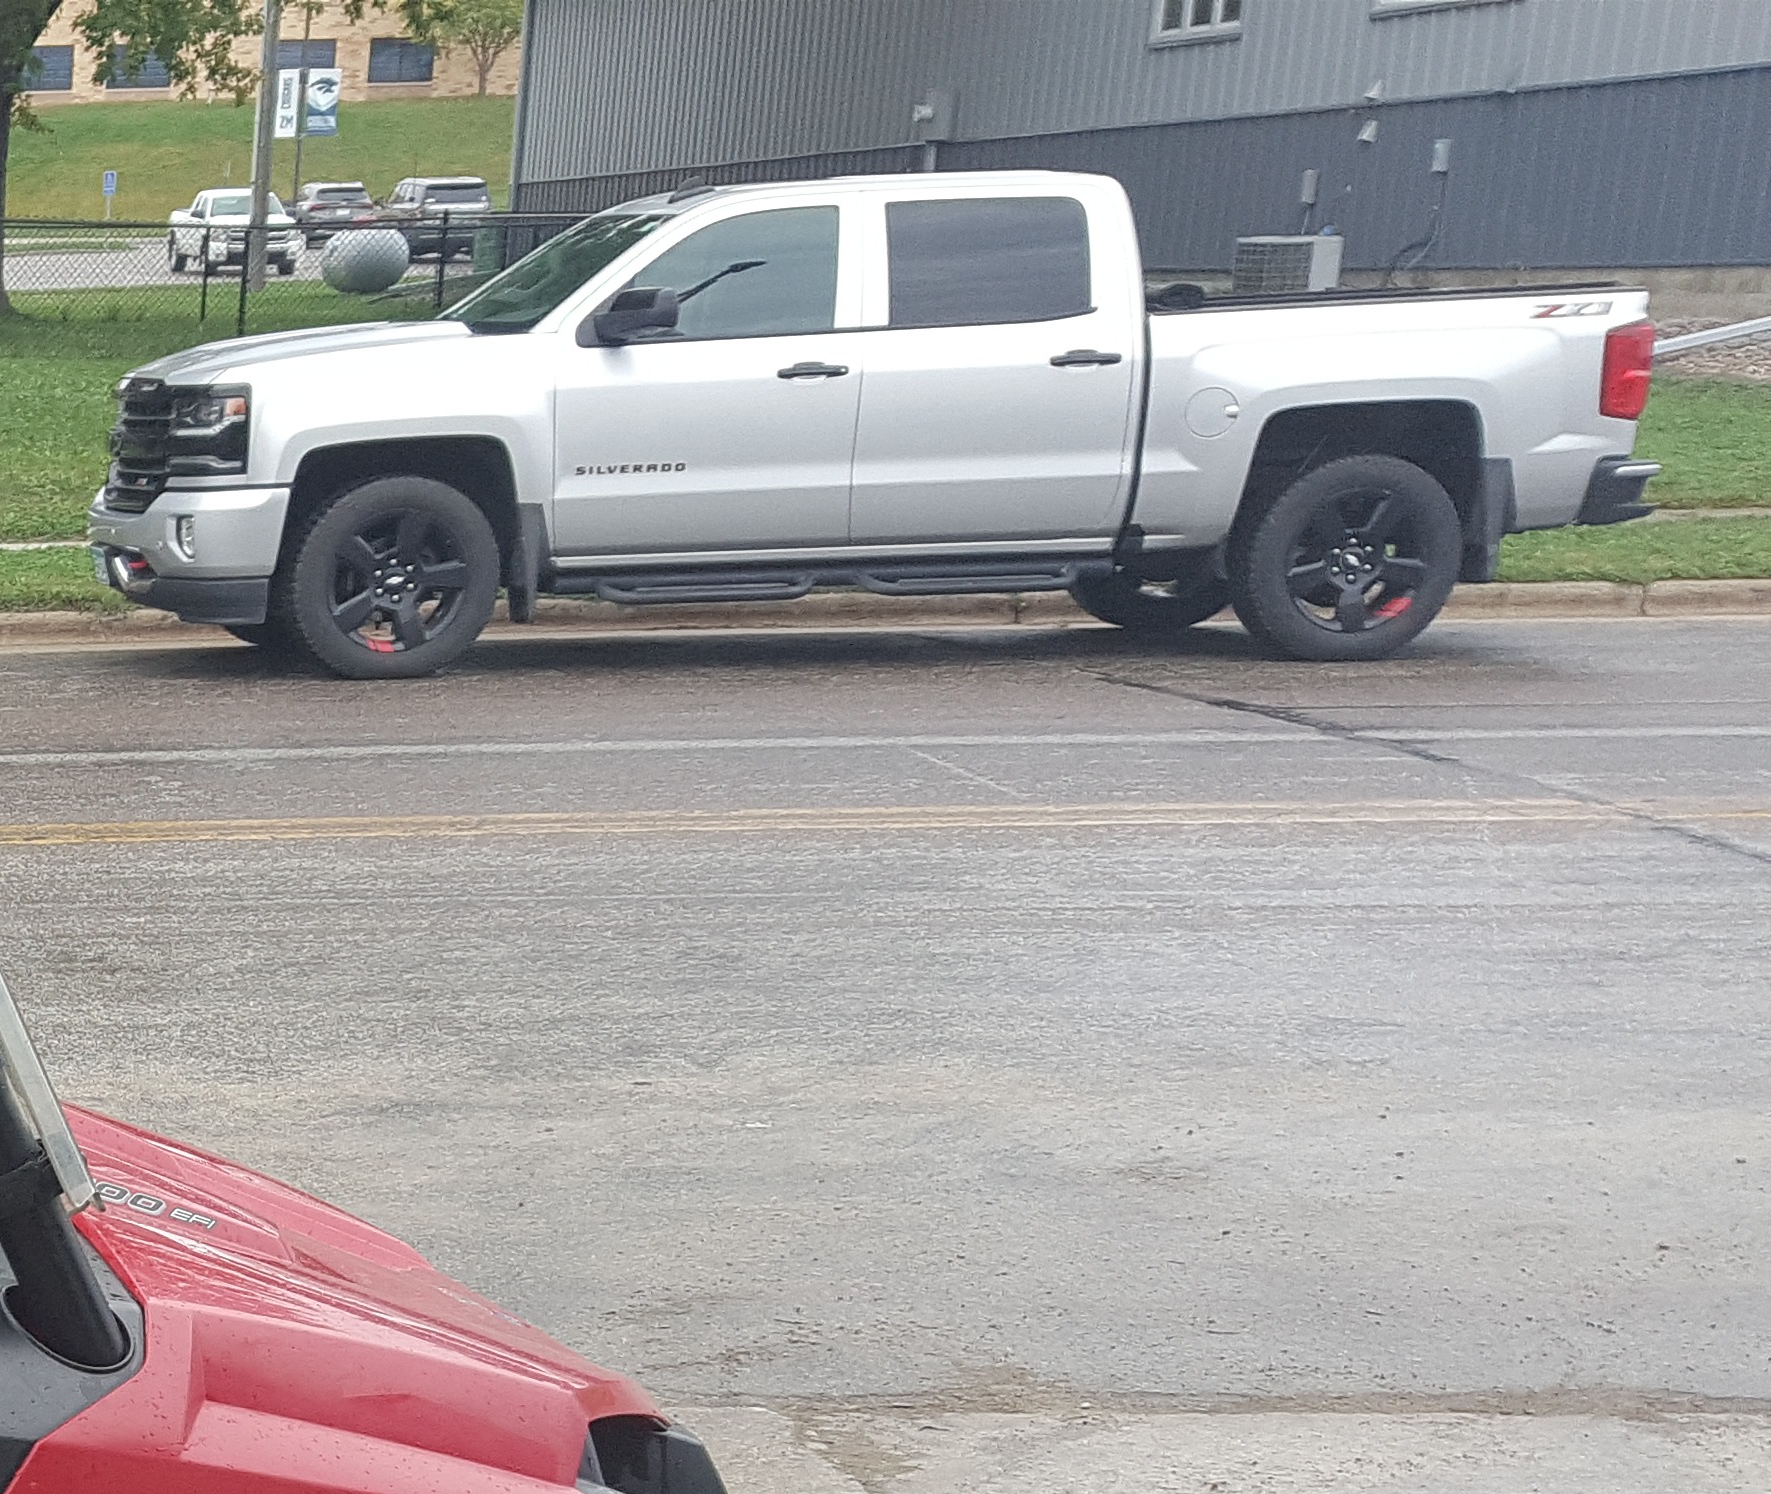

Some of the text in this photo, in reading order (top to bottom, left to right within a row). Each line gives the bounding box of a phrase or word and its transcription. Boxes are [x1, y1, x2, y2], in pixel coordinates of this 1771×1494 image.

[1528, 301, 1614, 318] Z71
[574, 462, 687, 476] SILVERADO
[169, 1206, 217, 1230] EFI
